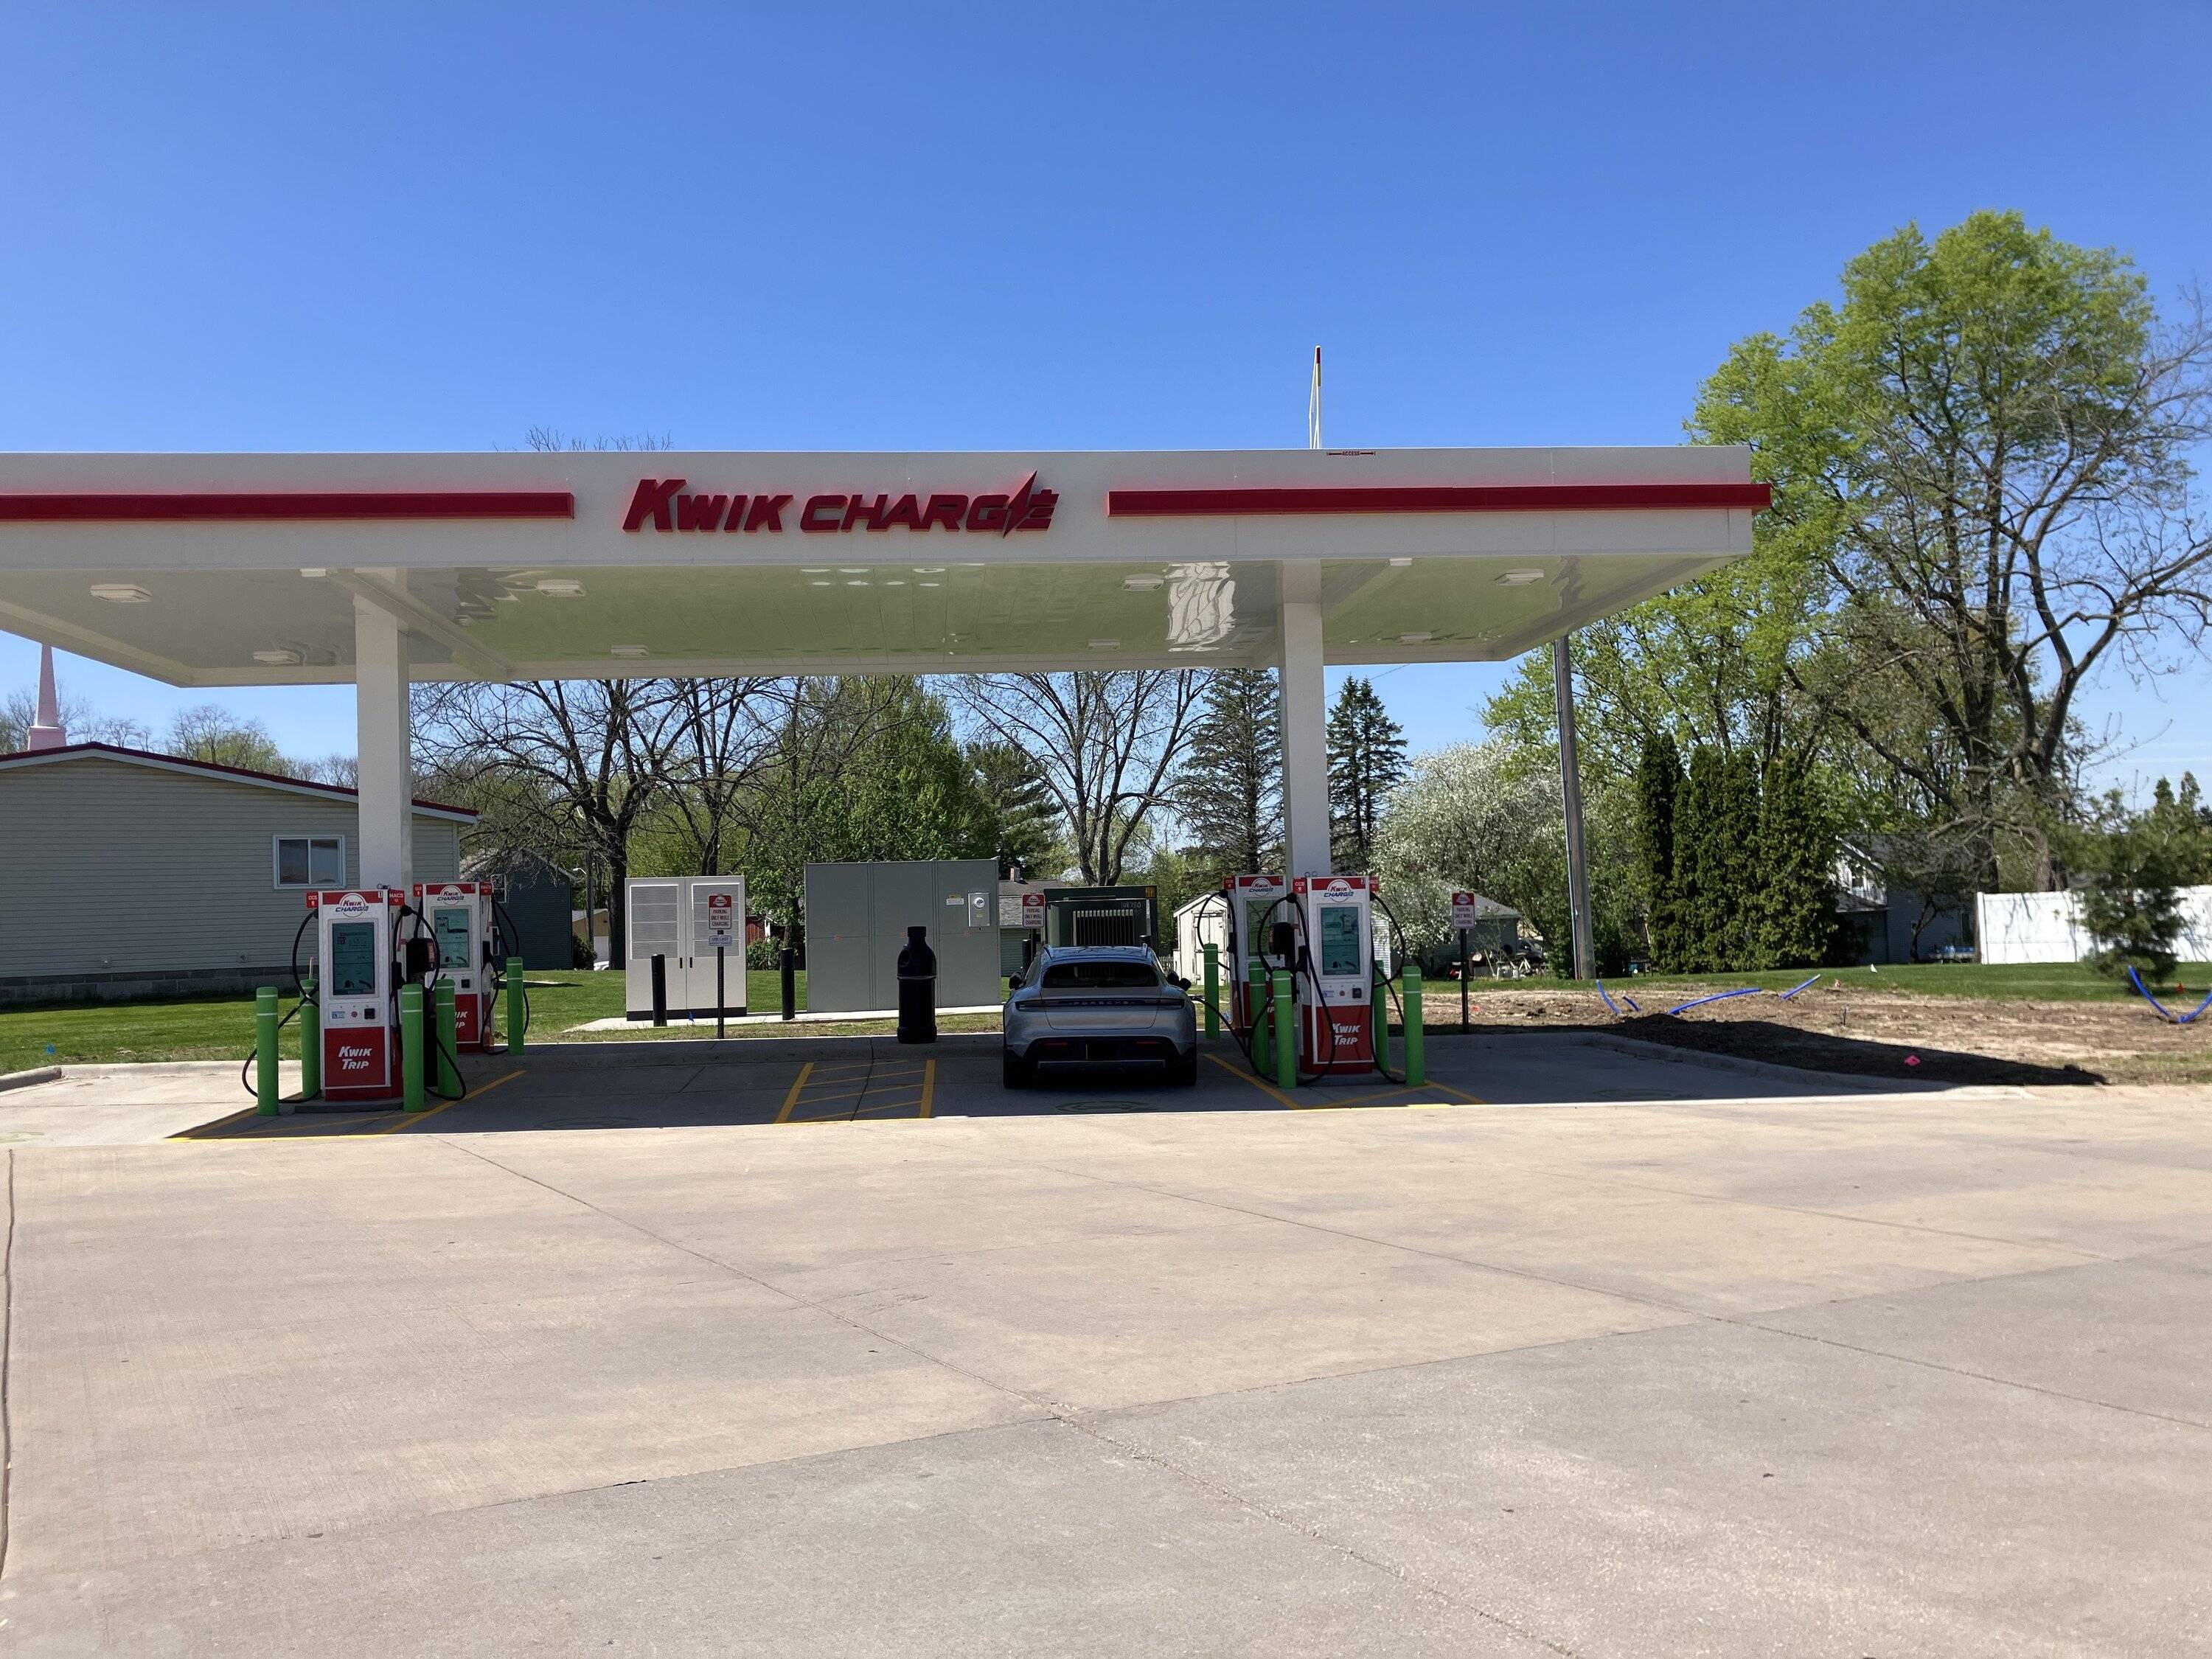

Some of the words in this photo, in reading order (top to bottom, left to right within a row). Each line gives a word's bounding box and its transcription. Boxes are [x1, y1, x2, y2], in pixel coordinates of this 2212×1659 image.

[622, 479, 793, 533] KWIK
[800, 470, 1060, 538] CHARGE
[1332, 1023, 1360, 1033] KWIK
[1335, 1035, 1358, 1045] TRIP
[338, 1046, 372, 1057] KWIK
[342, 1059, 369, 1070] TRIP
